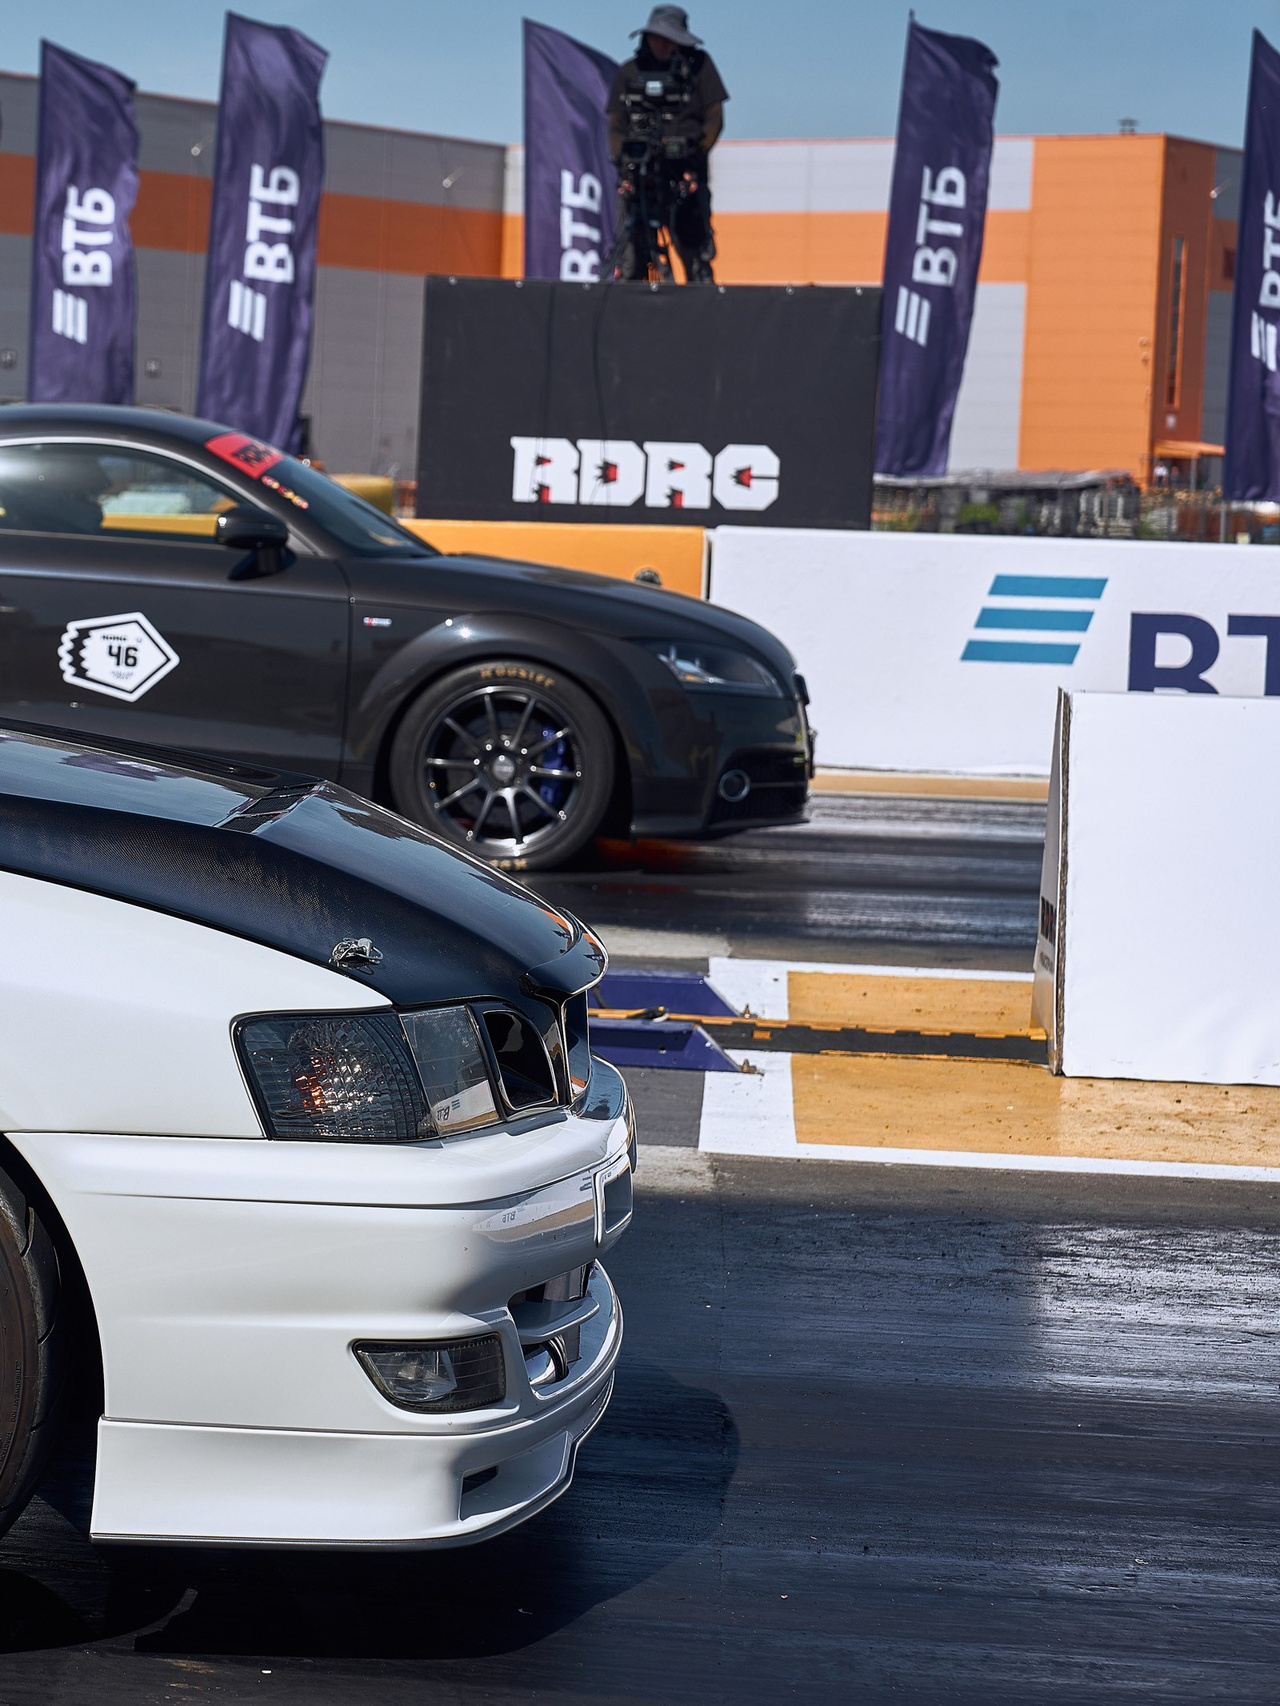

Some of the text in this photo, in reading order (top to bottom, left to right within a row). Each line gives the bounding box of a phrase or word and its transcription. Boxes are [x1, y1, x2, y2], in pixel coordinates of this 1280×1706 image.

[61, 185, 115, 287] ВТБ
[244, 163, 300, 284] ВТБ
[912, 165, 966, 287] ВТБ
[510, 436, 780, 511] RDRC
[108, 645, 138, 667] 46
[1127, 611, 1280, 696] ВТ
